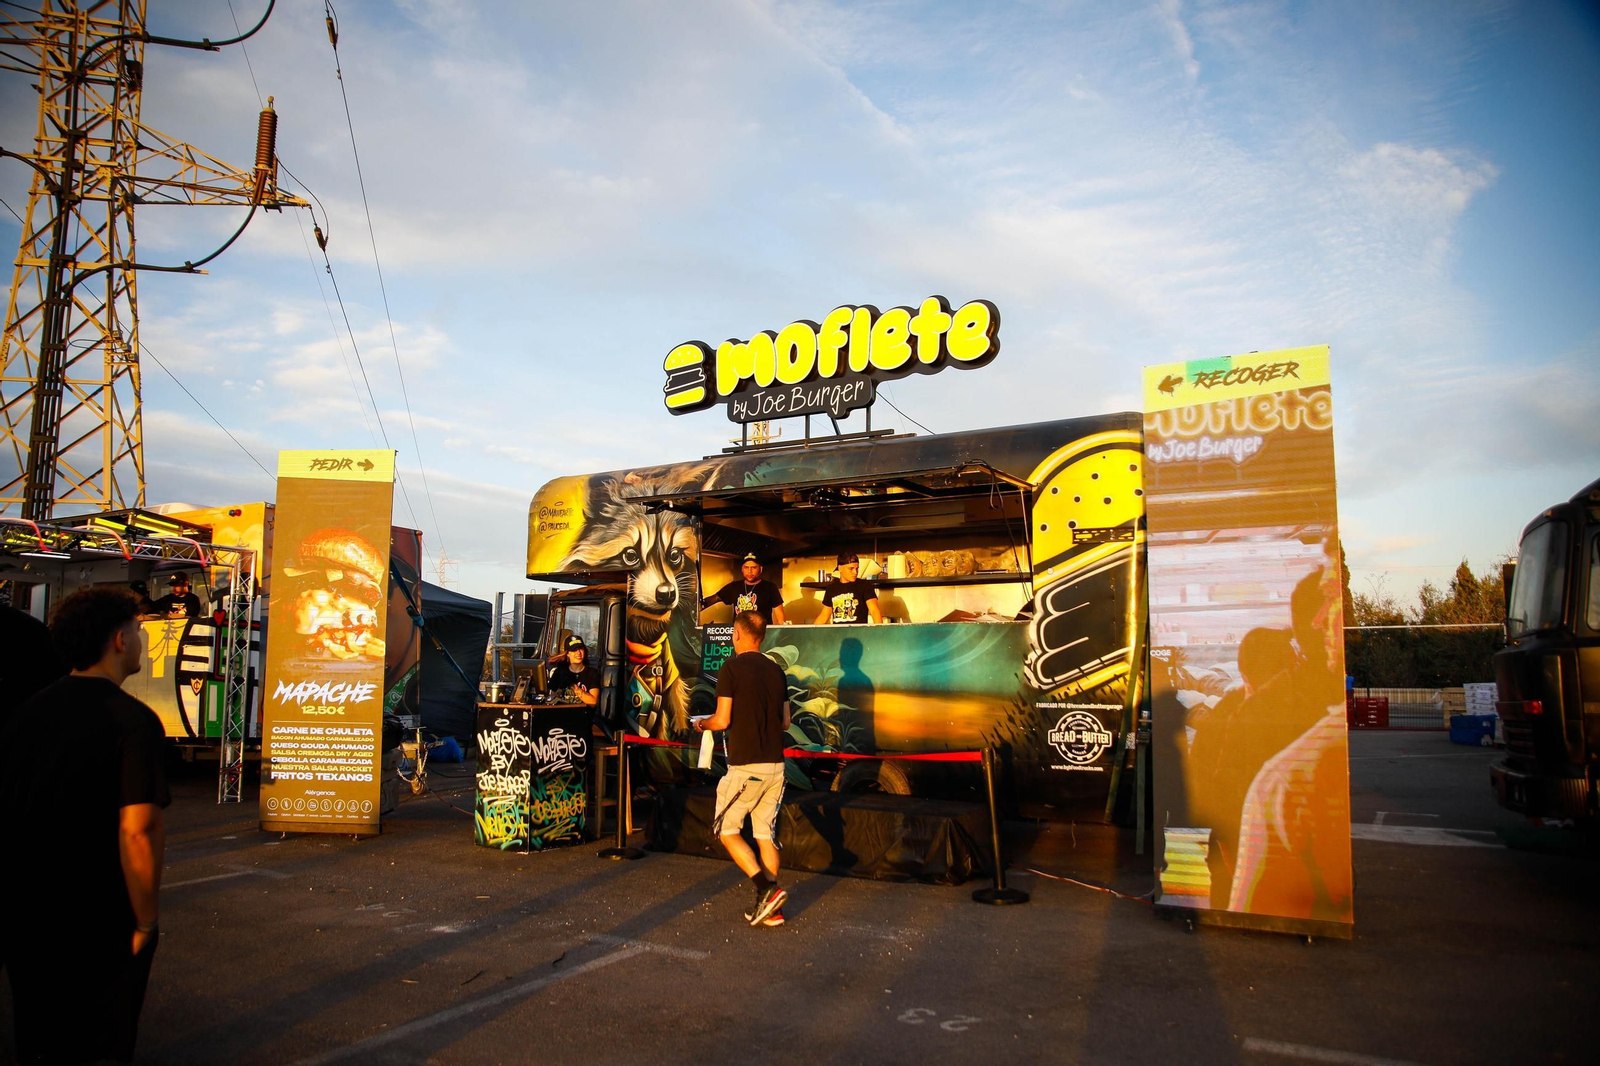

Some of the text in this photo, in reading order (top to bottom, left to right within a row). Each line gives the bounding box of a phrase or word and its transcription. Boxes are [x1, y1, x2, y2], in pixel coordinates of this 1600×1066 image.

[1193, 360, 1301, 389] RECOGER
[733, 380, 865, 420] by Joe Burger
[1164, 439, 1197, 460] Joe
[1197, 435, 1263, 462] Burger
[309, 457, 354, 472] PEDIR
[706, 626, 734, 635] RECOGE
[704, 643, 734, 657] Uber
[703, 657, 726, 670] Eat
[272, 678, 379, 706] MAPACHE
[301, 705, 345, 716] 12,50€
[309, 727, 324, 735] DE
[325, 728, 374, 736] CHULETA
[1051, 730, 1109, 744] BREAD BUTTER
[331, 743, 375, 751] AHUMADO
[271, 756, 308, 764] CEBOLLA
[271, 764, 374, 773] NUESTRA SALSA ROCKET
[271, 771, 373, 782] FRITOS TEXANOS
